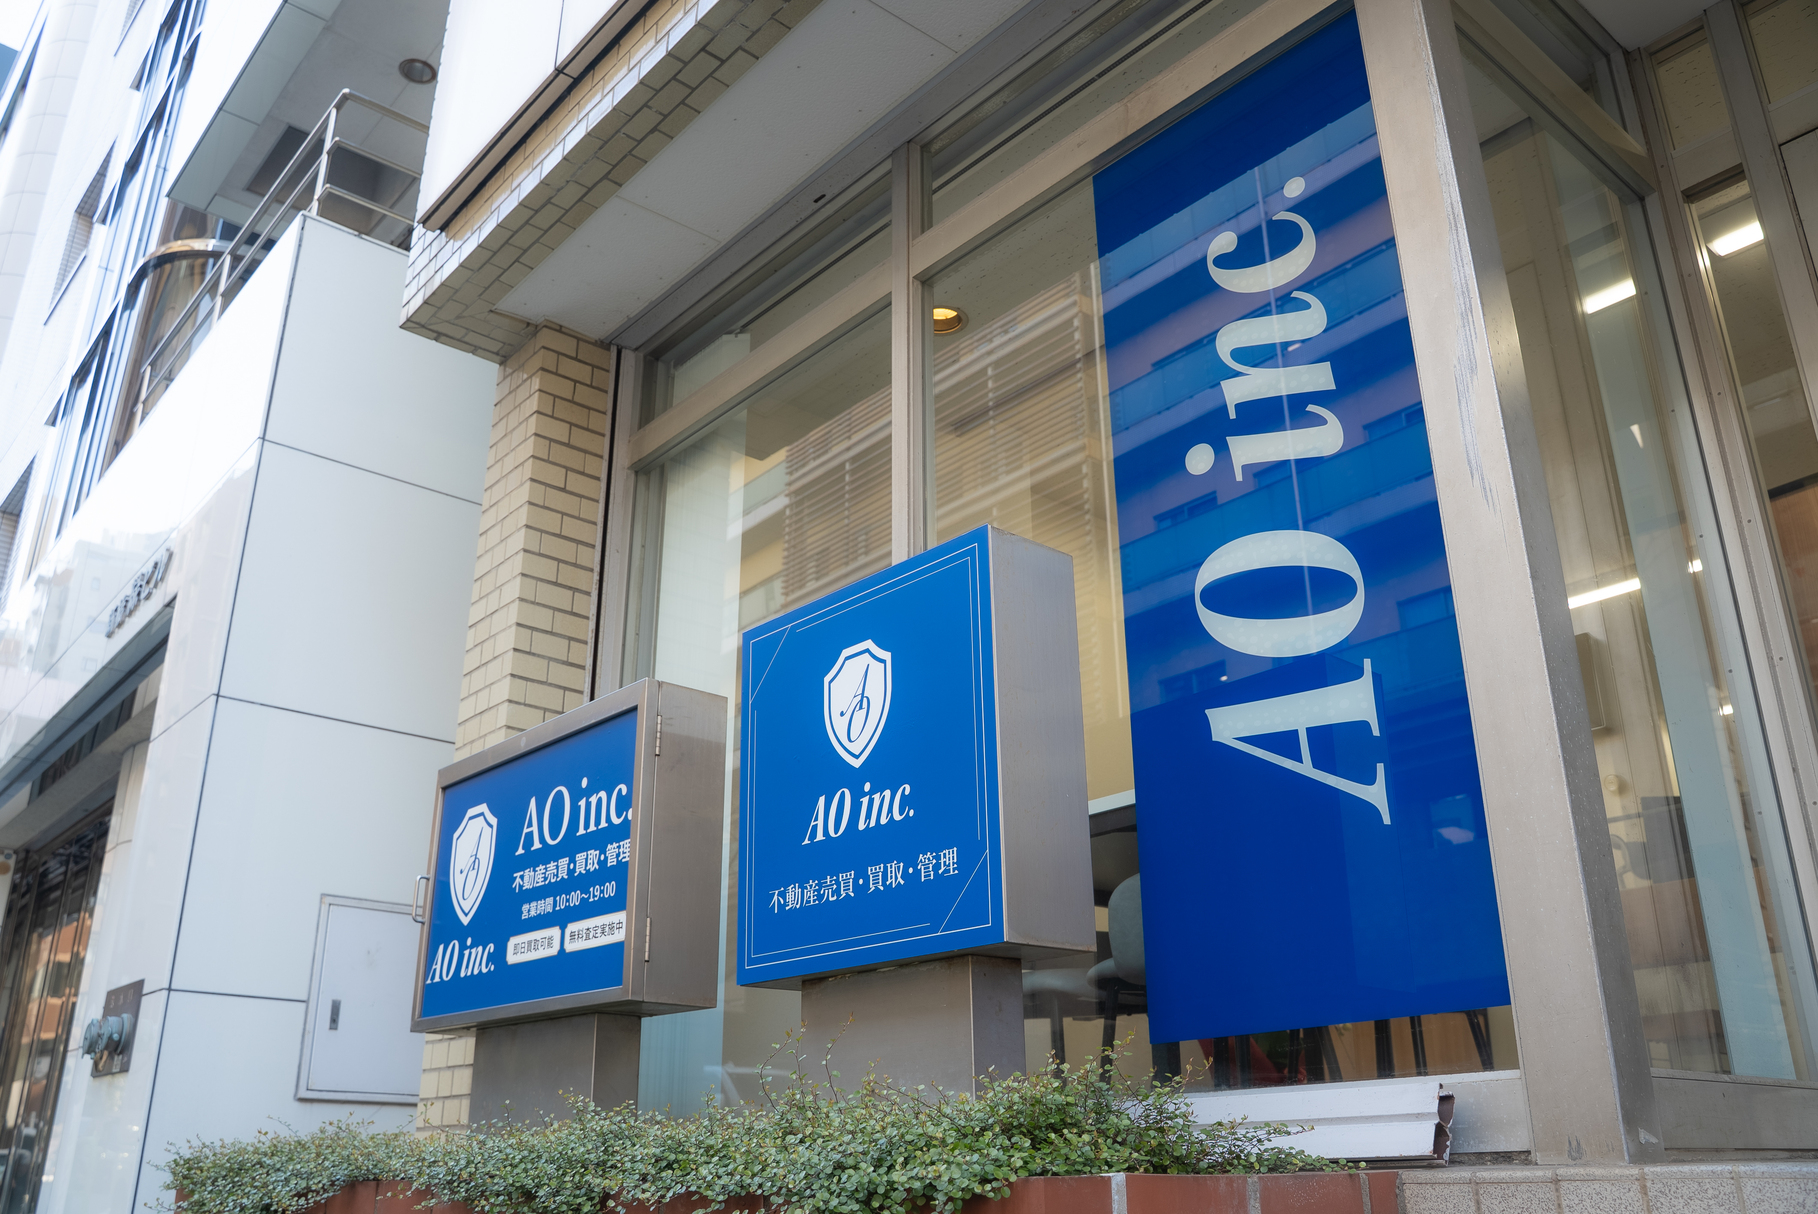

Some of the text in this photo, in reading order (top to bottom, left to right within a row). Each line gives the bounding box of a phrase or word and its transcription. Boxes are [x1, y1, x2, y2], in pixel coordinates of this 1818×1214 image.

[1185, 176, 1391, 825] AO inc.
[514, 776, 633, 856] AO inc.
[801, 781, 915, 846] AO inc.
[521, 896, 554, 920] 営業時間
[768, 846, 959, 914] 不動産売買・買取・管理
[425, 936, 495, 985] AO inc.
[512, 934, 555, 956] 即日買取可能
[568, 919, 624, 945] 無料査定実施中
